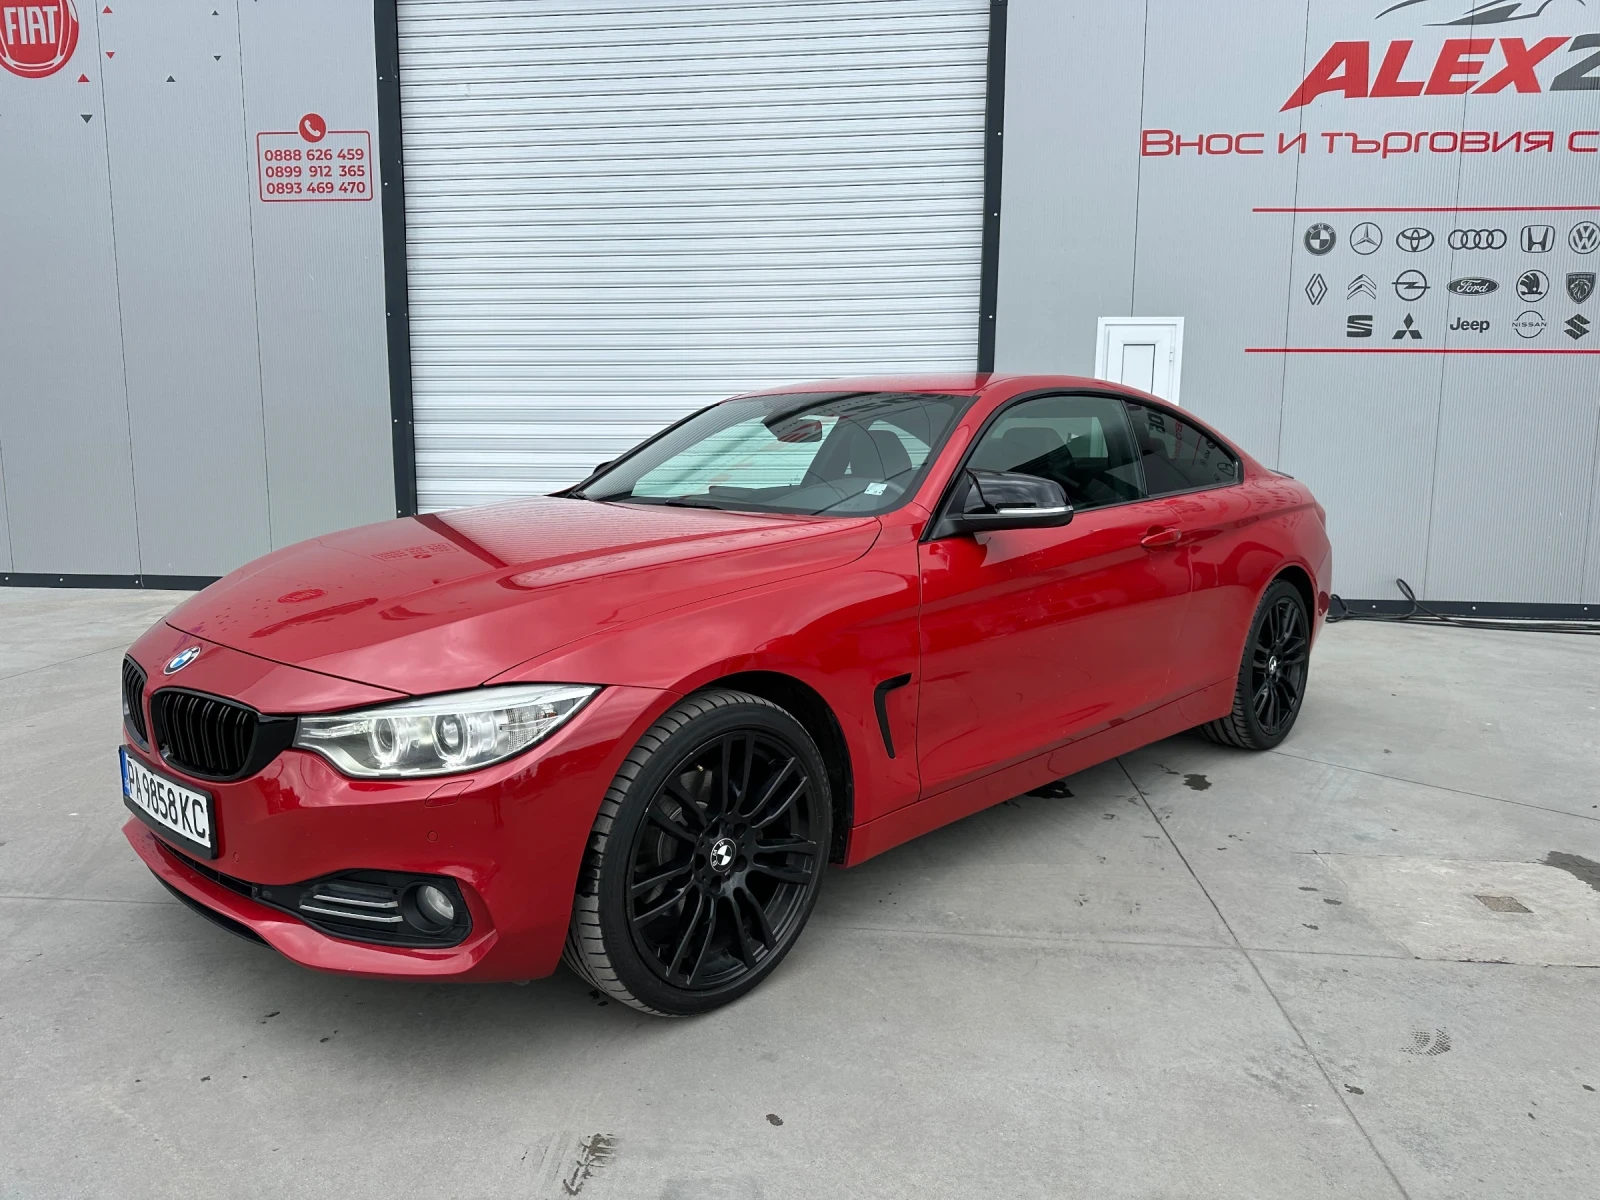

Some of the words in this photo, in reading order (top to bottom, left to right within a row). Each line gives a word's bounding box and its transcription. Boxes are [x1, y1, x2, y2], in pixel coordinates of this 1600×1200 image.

[3, 6, 58, 45] FIAT
[264, 149, 302, 162] 0888
[306, 148, 333, 161] 626
[337, 148, 364, 160] 459
[265, 166, 302, 178] 0899
[309, 165, 333, 177] 912
[339, 165, 365, 177] 365
[266, 182, 303, 194] 0893
[306, 181, 334, 193] 469
[338, 181, 366, 193] 470
[1456, 280, 1489, 293] Ford
[1450, 317, 1490, 333] Jeep
